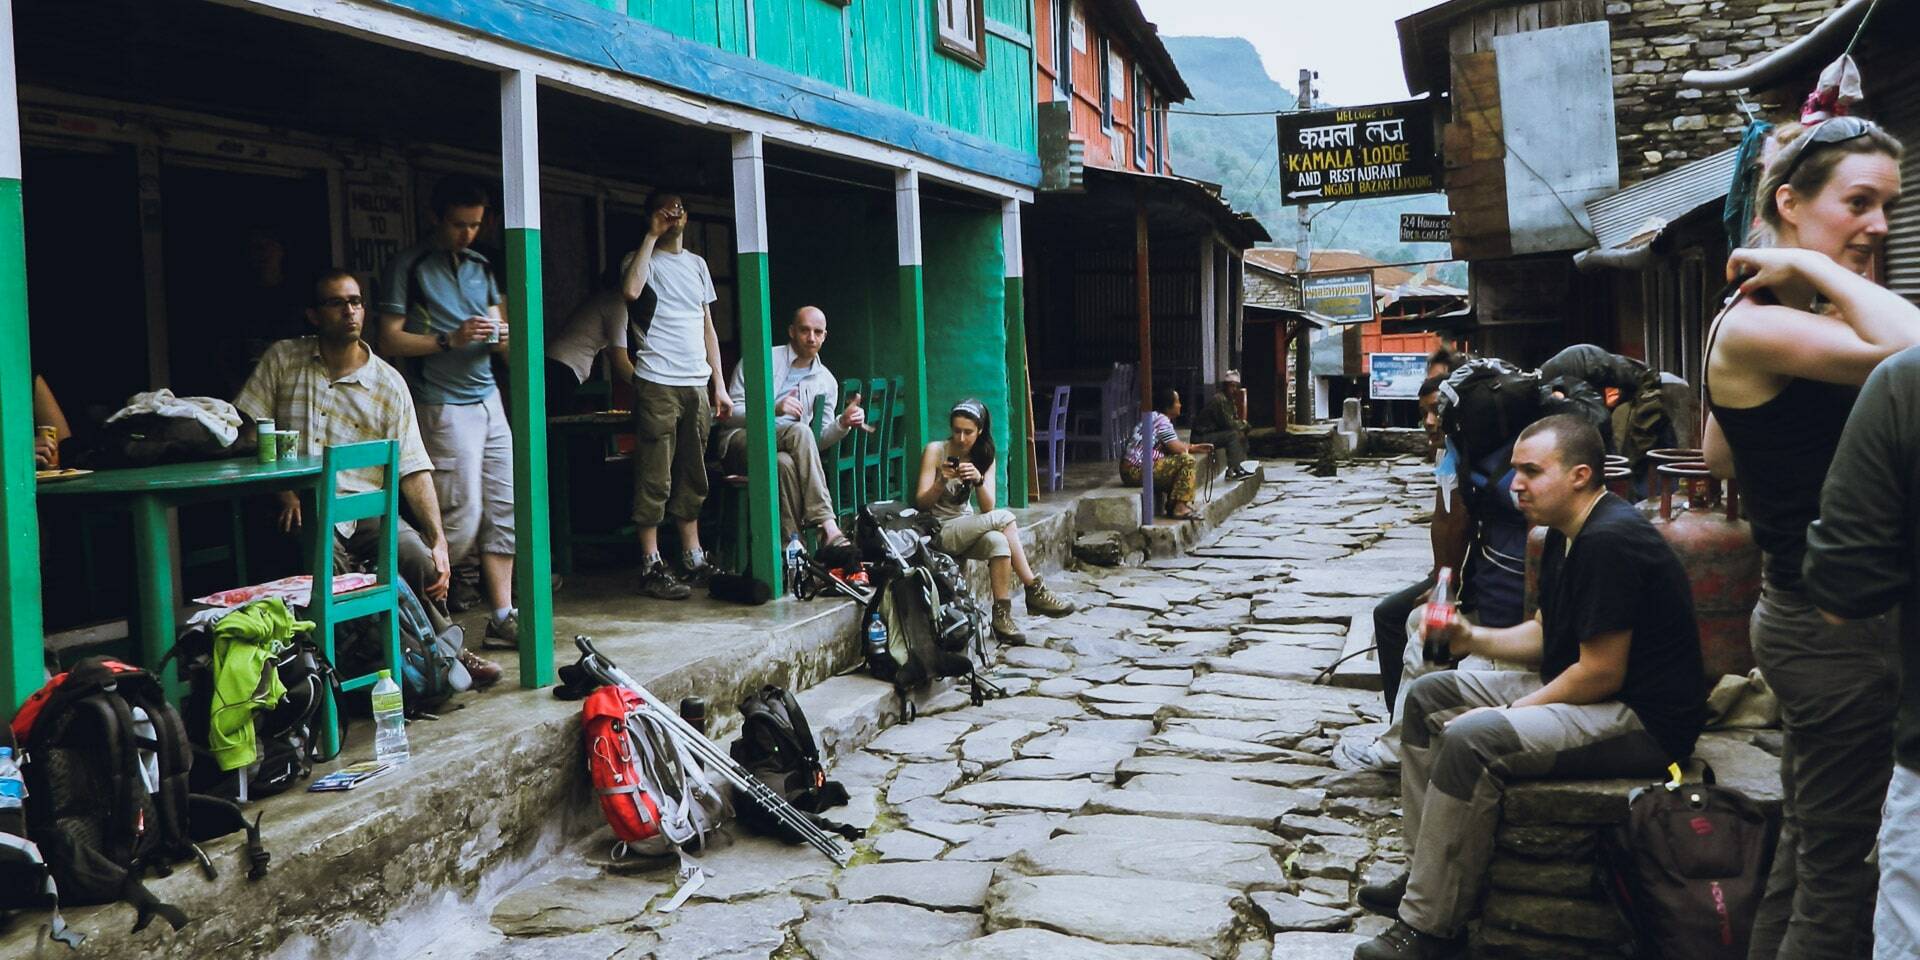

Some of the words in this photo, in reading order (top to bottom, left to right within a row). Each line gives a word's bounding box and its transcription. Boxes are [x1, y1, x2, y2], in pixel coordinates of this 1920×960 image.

[1298, 123, 1357, 150] कमला
[1366, 118, 1405, 143] लज
[1288, 148, 1355, 173] KAMALA
[1361, 142, 1411, 166] LODGE
[1298, 171, 1322, 187] AND
[1329, 163, 1403, 183] RESTAURANT
[1324, 183, 1354, 197] NGADI
[1359, 179, 1391, 193] BAZAR
[1392, 175, 1433, 191] LAMJUNG
[352, 192, 402, 213] WELCOME
[368, 215, 387, 234] TO
[1402, 215, 1416, 228] 24
